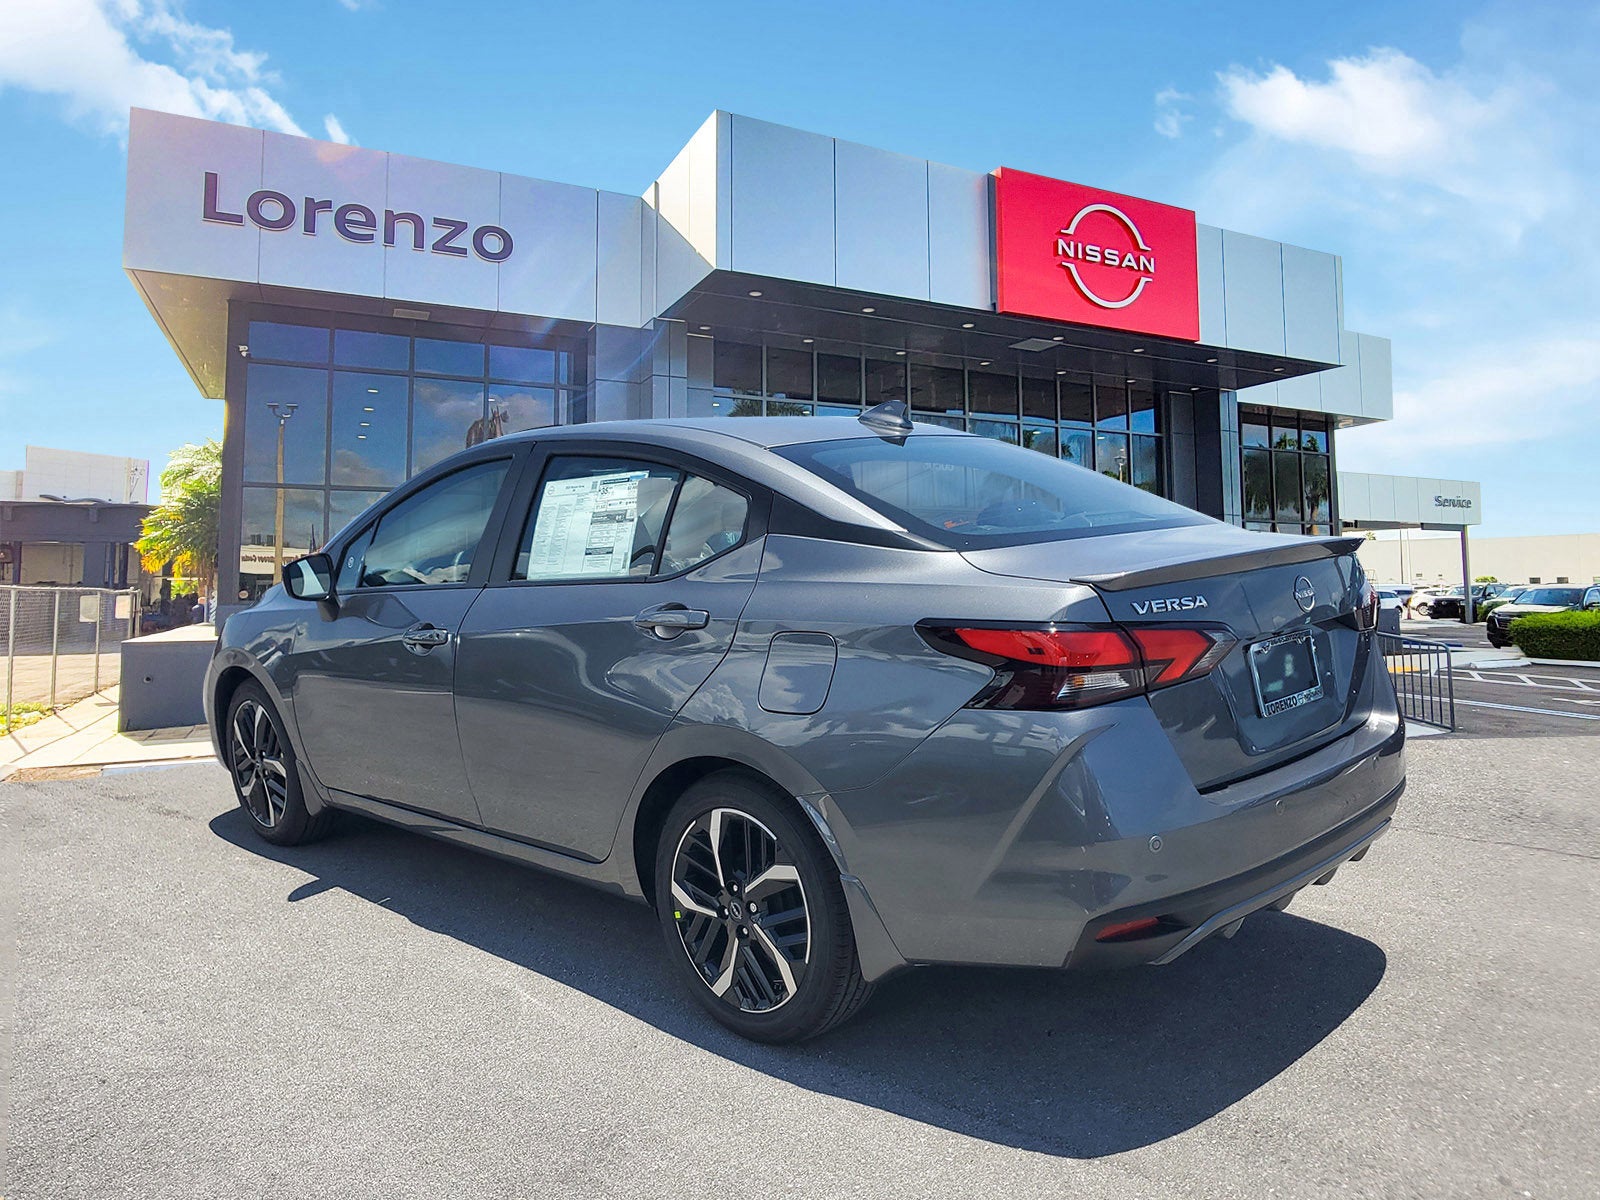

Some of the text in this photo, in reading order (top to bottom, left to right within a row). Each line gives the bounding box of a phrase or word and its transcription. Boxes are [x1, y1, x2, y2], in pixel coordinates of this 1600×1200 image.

[203, 171, 514, 262] Lorenzo
[1057, 238, 1155, 273] NISSAN
[1435, 495, 1472, 508] Service
[1132, 596, 1209, 615] VERSA
[1266, 695, 1298, 716] LORENZO
